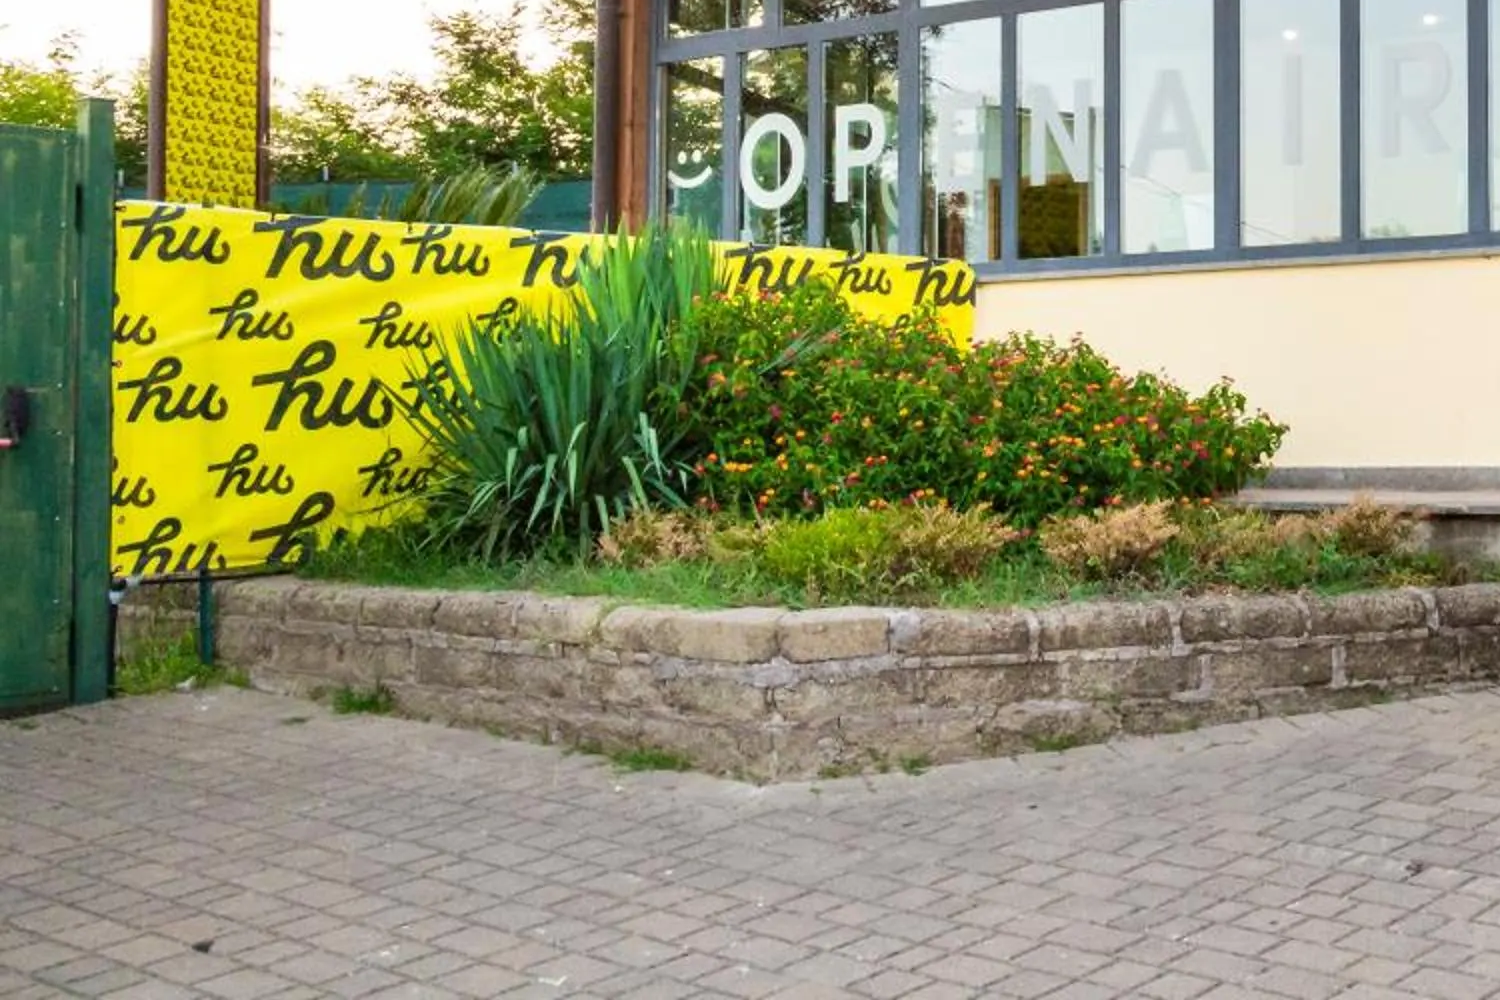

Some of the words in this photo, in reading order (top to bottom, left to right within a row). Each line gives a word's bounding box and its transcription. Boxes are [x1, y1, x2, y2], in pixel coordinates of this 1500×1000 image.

[122, 206, 230, 264] hu
[253, 217, 395, 281] hu
[401, 225, 490, 276] hu
[830, 251, 891, 294] hu
[112, 292, 156, 345] u
[209, 288, 294, 340] hu
[359, 301, 432, 348] hu
[118, 356, 229, 423] hu
[252, 340, 396, 431] hu
[112, 456, 155, 508] u
[208, 443, 294, 497] hu
[358, 447, 429, 497] hu
[118, 518, 227, 576] hu
